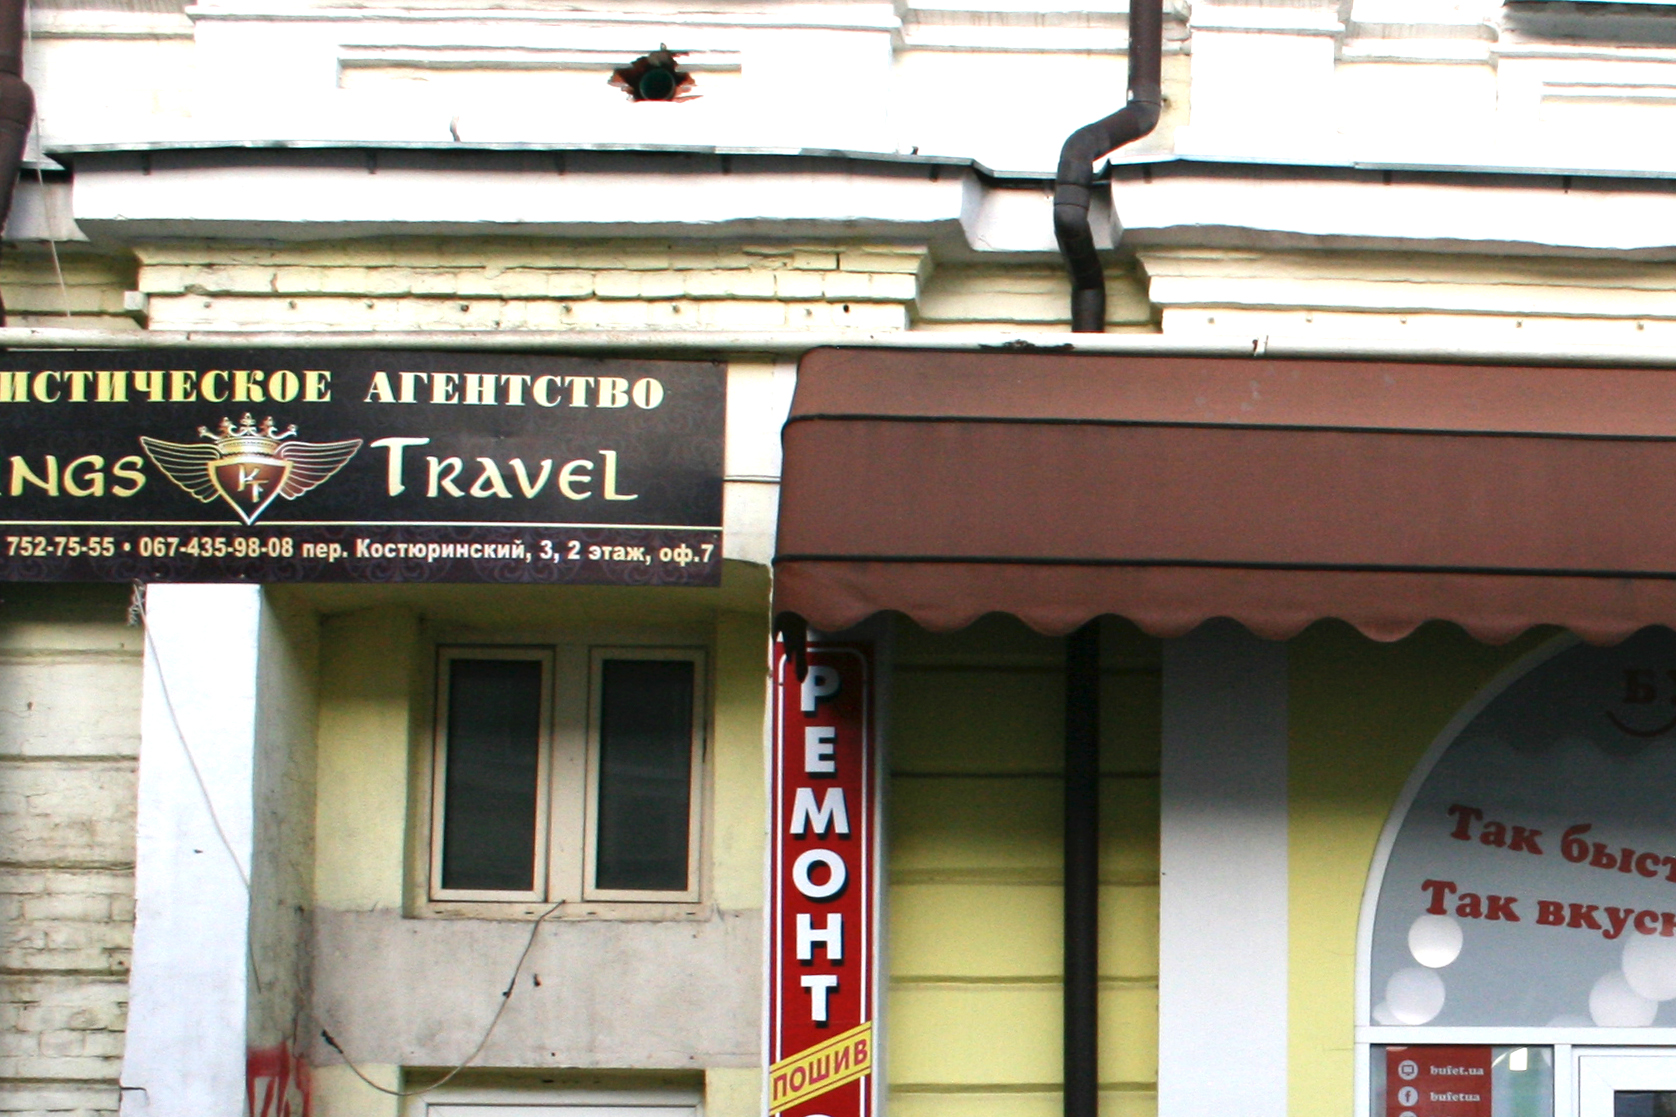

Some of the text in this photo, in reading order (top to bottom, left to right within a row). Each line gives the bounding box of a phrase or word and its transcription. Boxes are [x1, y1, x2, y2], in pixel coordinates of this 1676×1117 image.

[0, 369, 665, 410] ИСТИЧЕСКОЕ АГЕНТСТВО
[0, 454, 147, 497] NGS
[6, 536, 115, 557] 752-75-55
[139, 536, 294, 558] 067-435-98-08
[302, 541, 349, 563] пер.
[355, 537, 532, 562] Костюринский,
[567, 540, 581, 560] 2
[588, 544, 652, 567] этаж,
[789, 664, 850, 1022] РЕМОНТ
[1447, 803, 1544, 856] Так
[1420, 878, 1522, 923] Так
[773, 1038, 869, 1102] ПОШИВ
[1430, 1065, 1485, 1076] bufet.ua
[1430, 1091, 1481, 1102] bufetua
